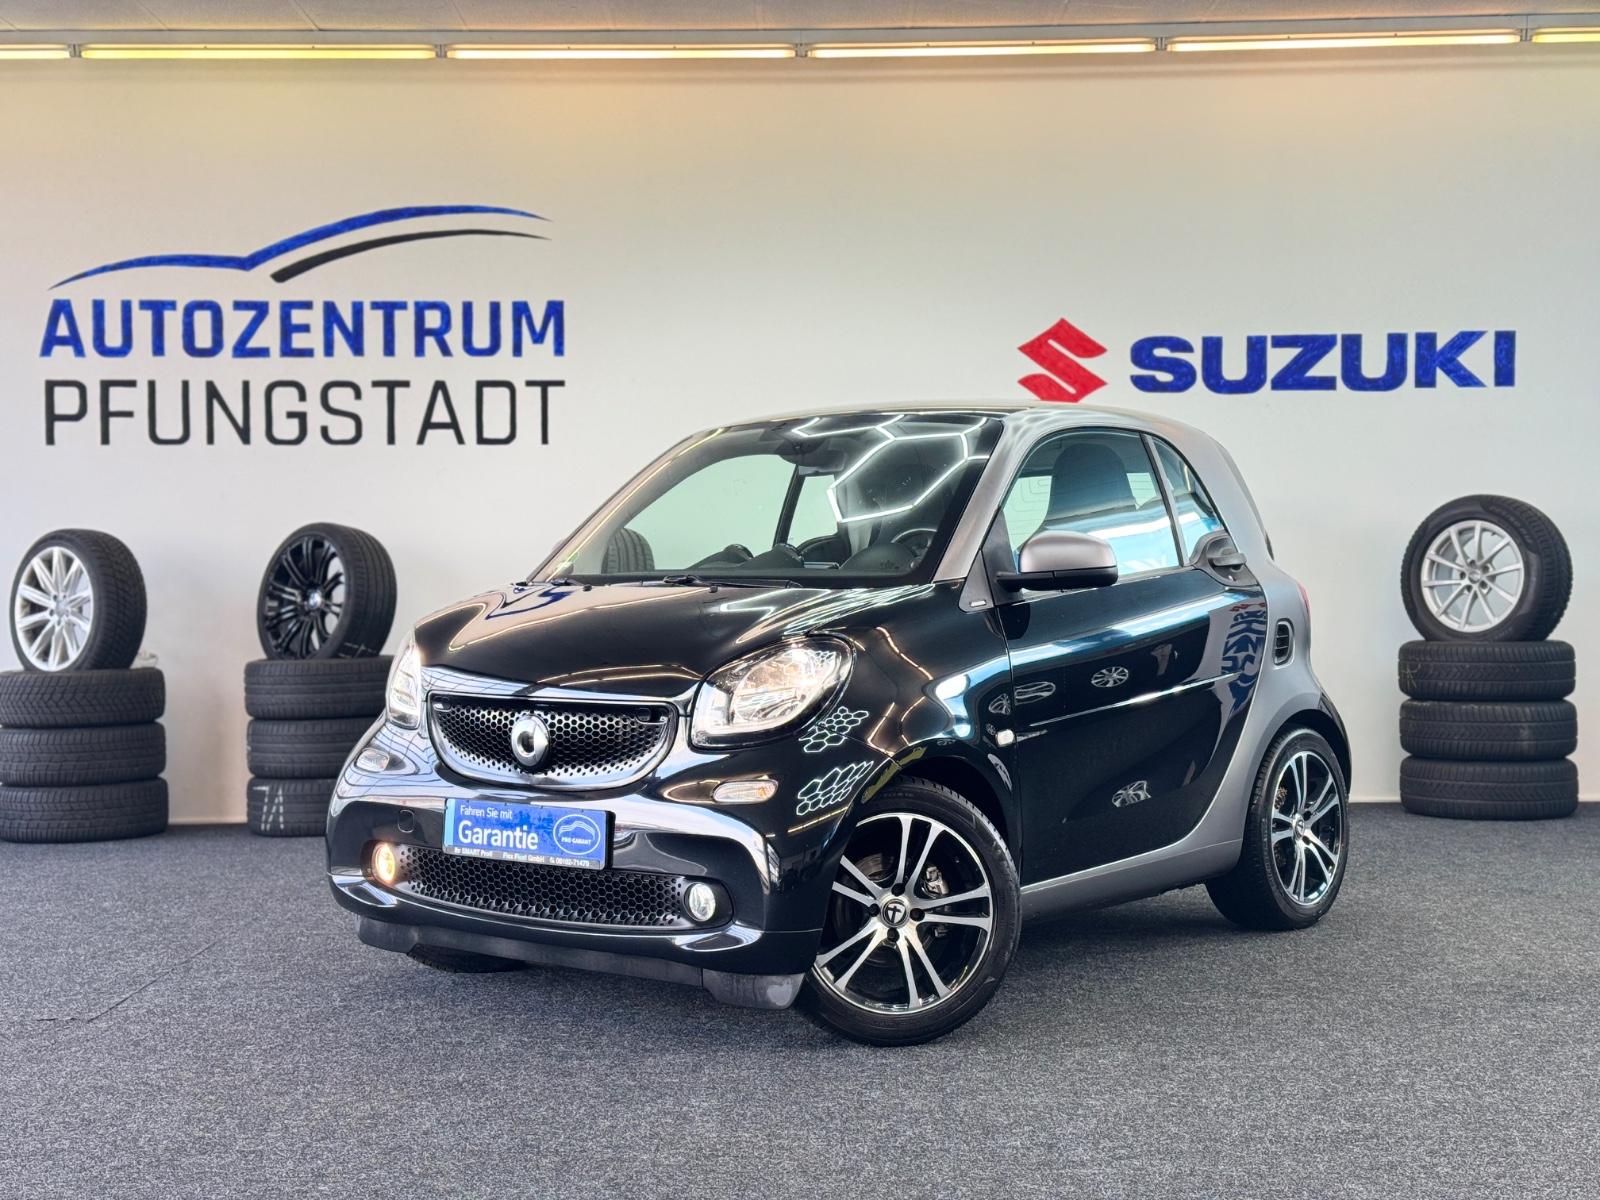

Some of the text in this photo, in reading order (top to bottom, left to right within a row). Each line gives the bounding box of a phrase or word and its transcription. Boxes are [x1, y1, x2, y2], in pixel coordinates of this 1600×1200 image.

[40, 299, 565, 358] AUTOZENTRUM
[1130, 330, 1516, 394] SUZUKI
[44, 379, 566, 446] PFUNGSTADT
[458, 820, 538, 850] Garantie
[460, 805, 513, 819] Fahren Sie mit
